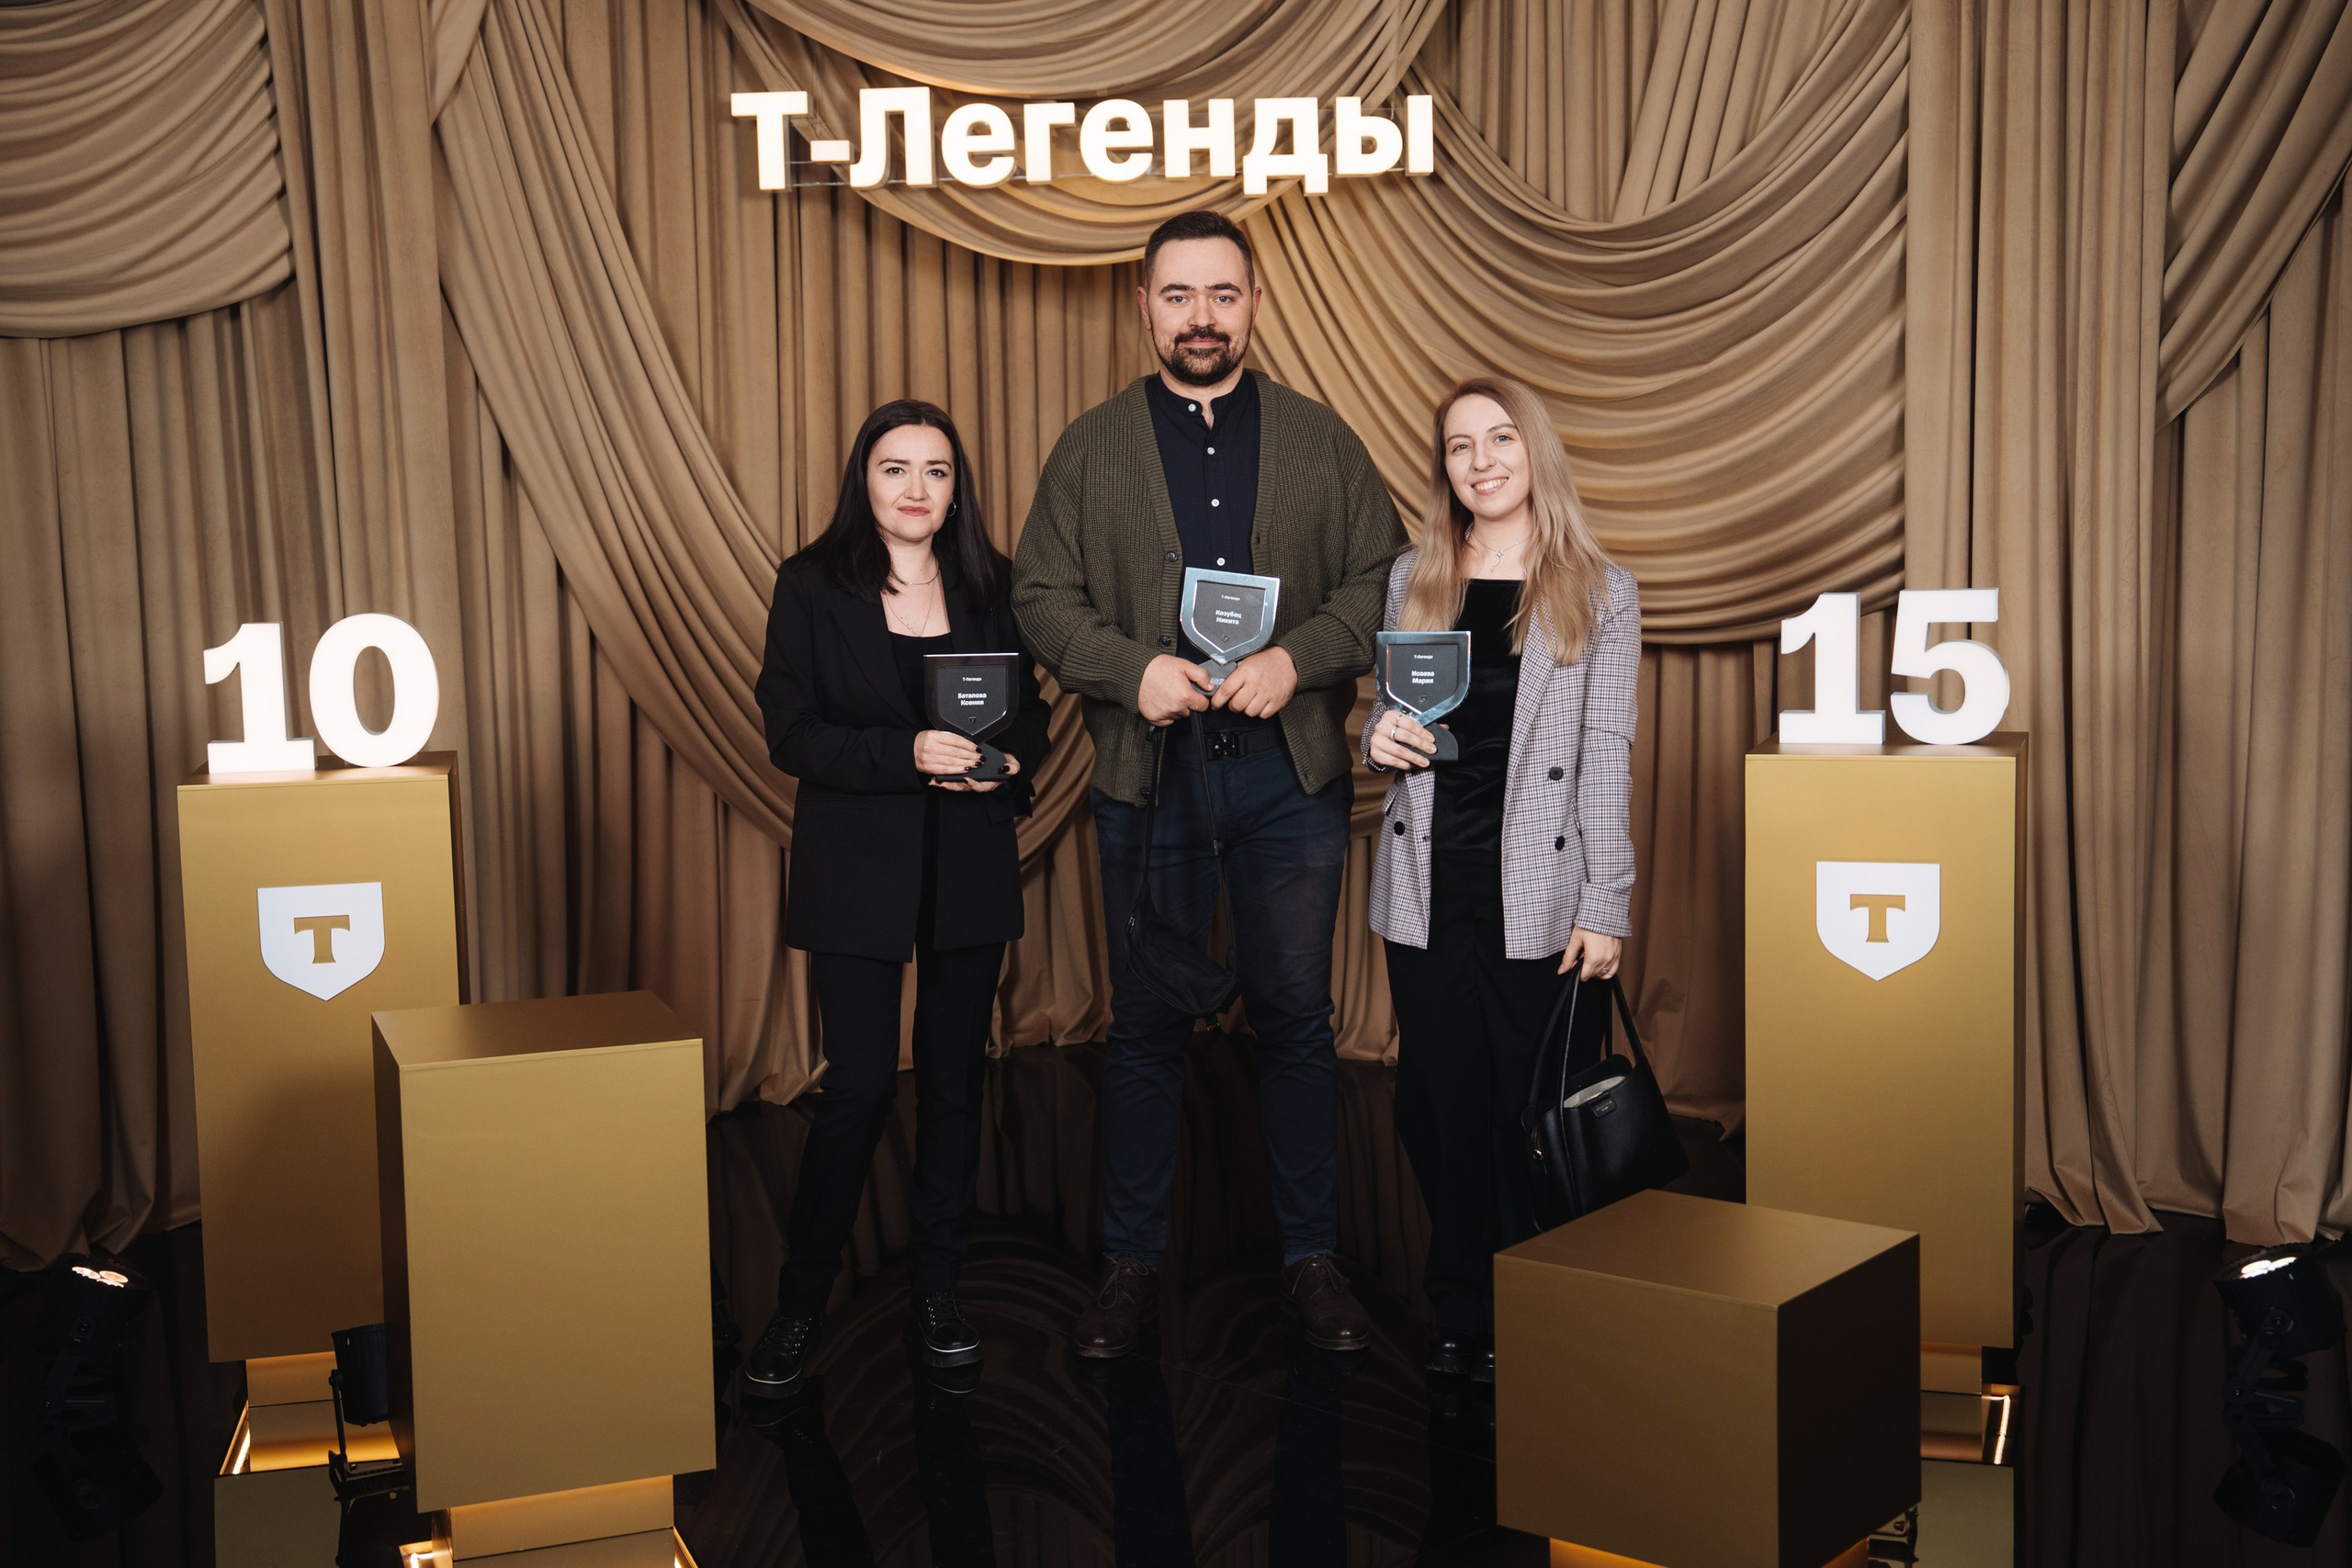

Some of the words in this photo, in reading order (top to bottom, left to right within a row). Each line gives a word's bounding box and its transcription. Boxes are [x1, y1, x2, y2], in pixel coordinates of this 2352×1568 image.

[730, 86, 1434, 196] Т-Легенды
[1216, 610, 1241, 618] Козубец
[1779, 587, 2010, 745] 15
[203, 613, 439, 773] 10
